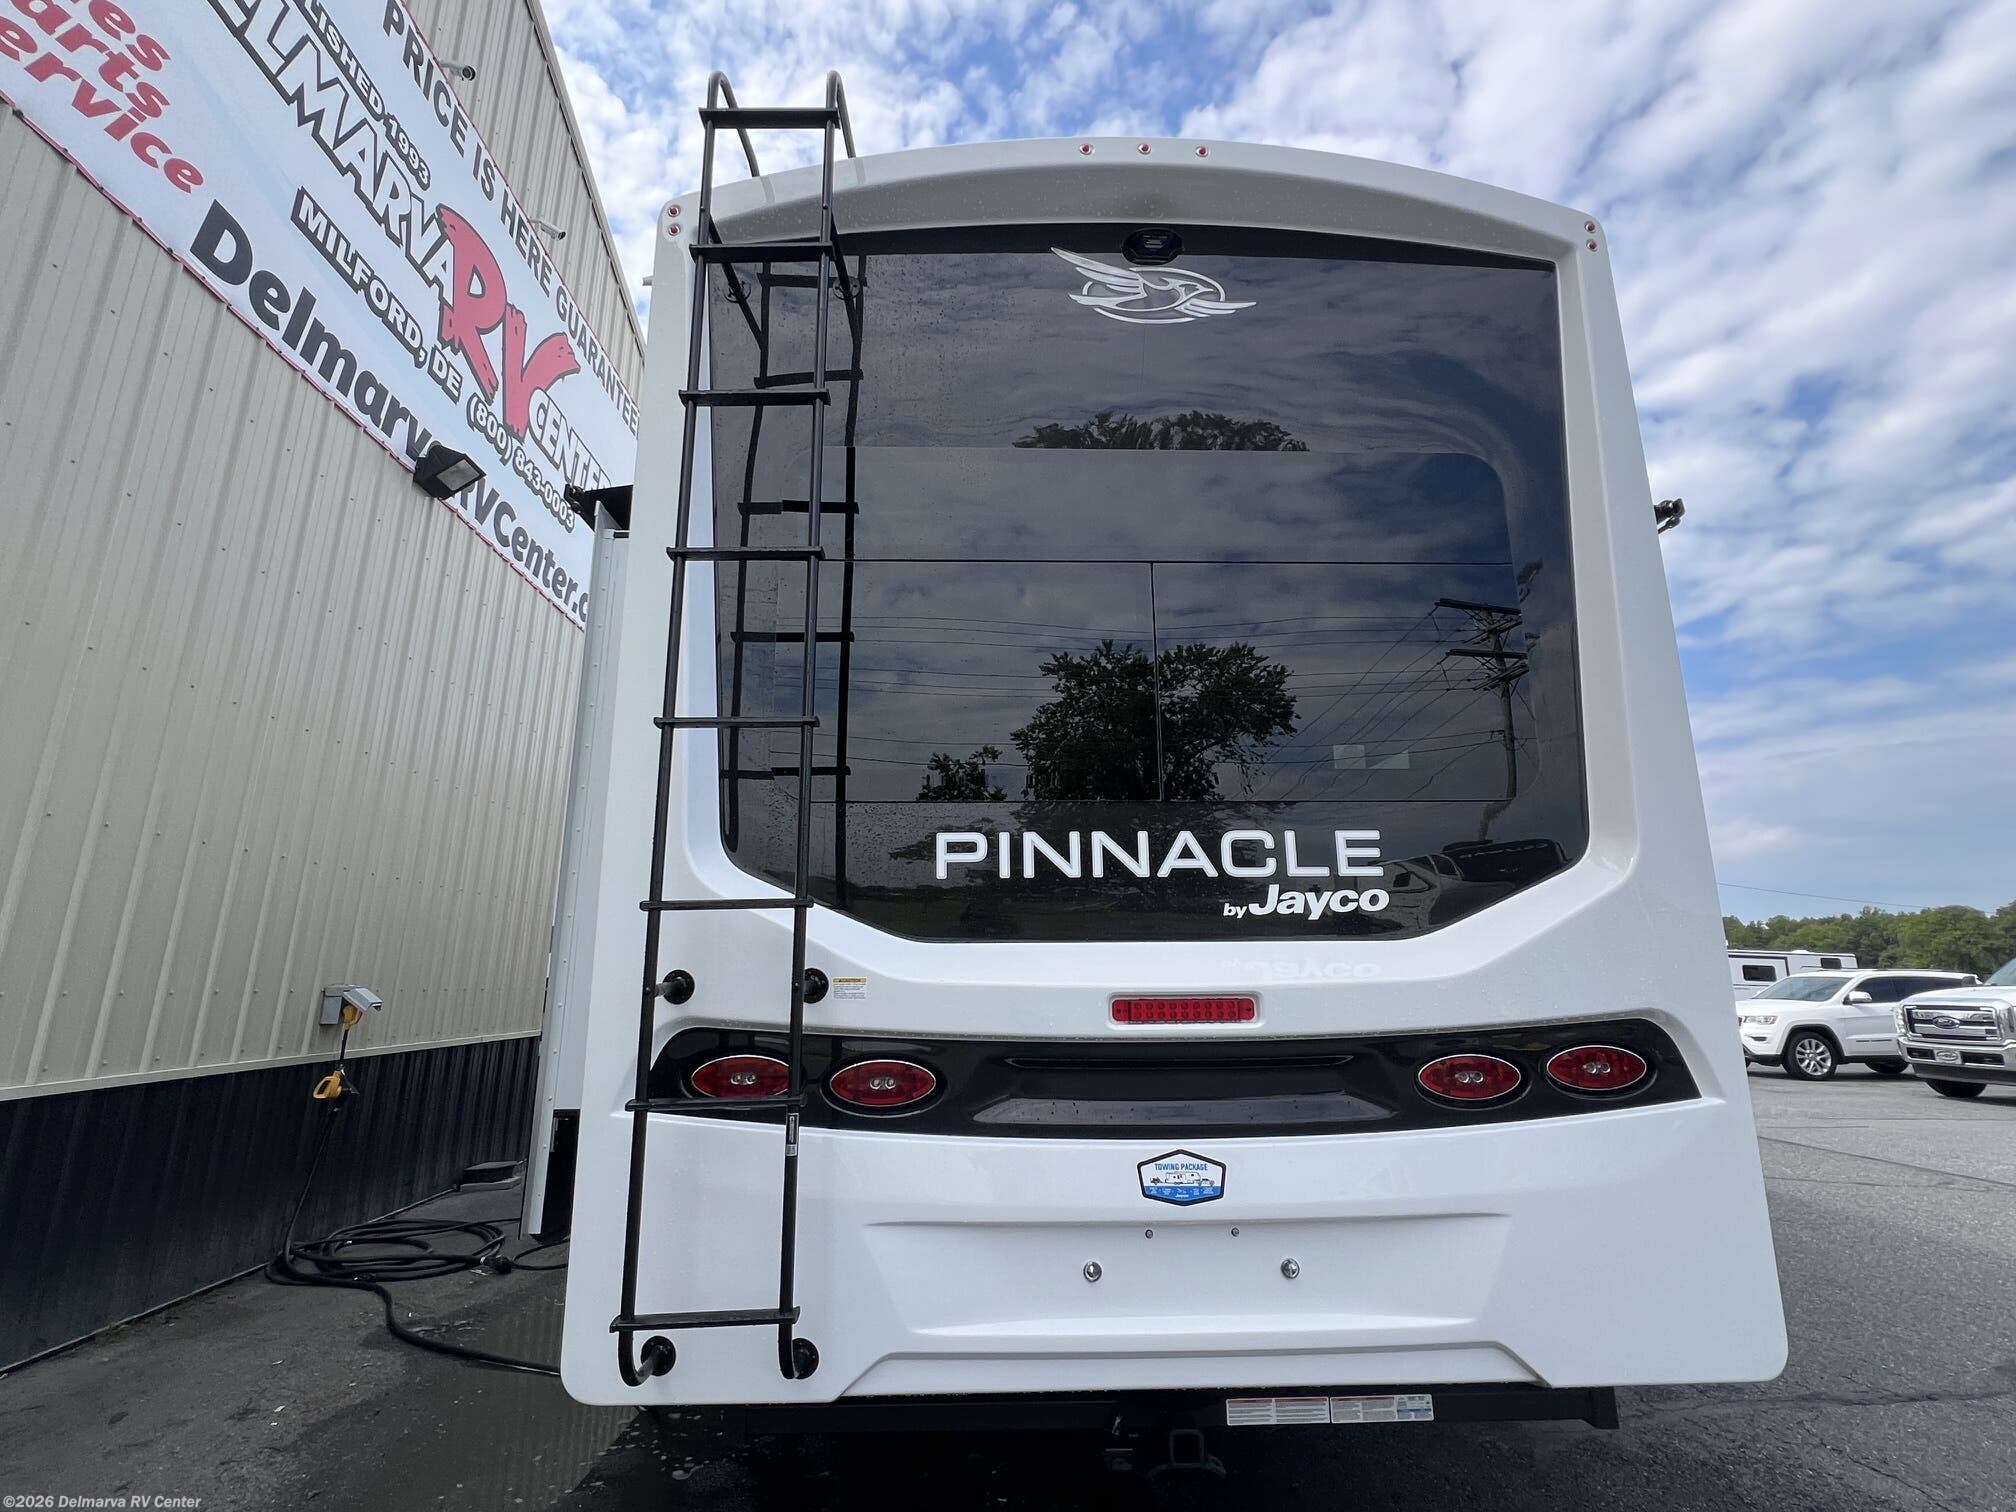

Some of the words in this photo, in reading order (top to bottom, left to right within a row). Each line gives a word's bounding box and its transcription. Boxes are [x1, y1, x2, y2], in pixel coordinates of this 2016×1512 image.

[382, 0, 467, 158] PRICE
[473, 142, 496, 201] IS
[501, 189, 552, 298] HERE
[385, 112, 431, 191] 1993
[291, 186, 427, 368] MILFORD,
[427, 344, 463, 404] DE
[466, 393, 527, 465] (800)
[512, 446, 576, 533] 843-0003
[436, 203, 582, 438] RV
[935, 829, 1386, 880] PINNACLE
[1223, 903, 1247, 919] by
[1249, 884, 1390, 921] Jayco
[1154, 1163, 1179, 1171] TOWING
[1180, 1163, 1208, 1171] PACKAGE
